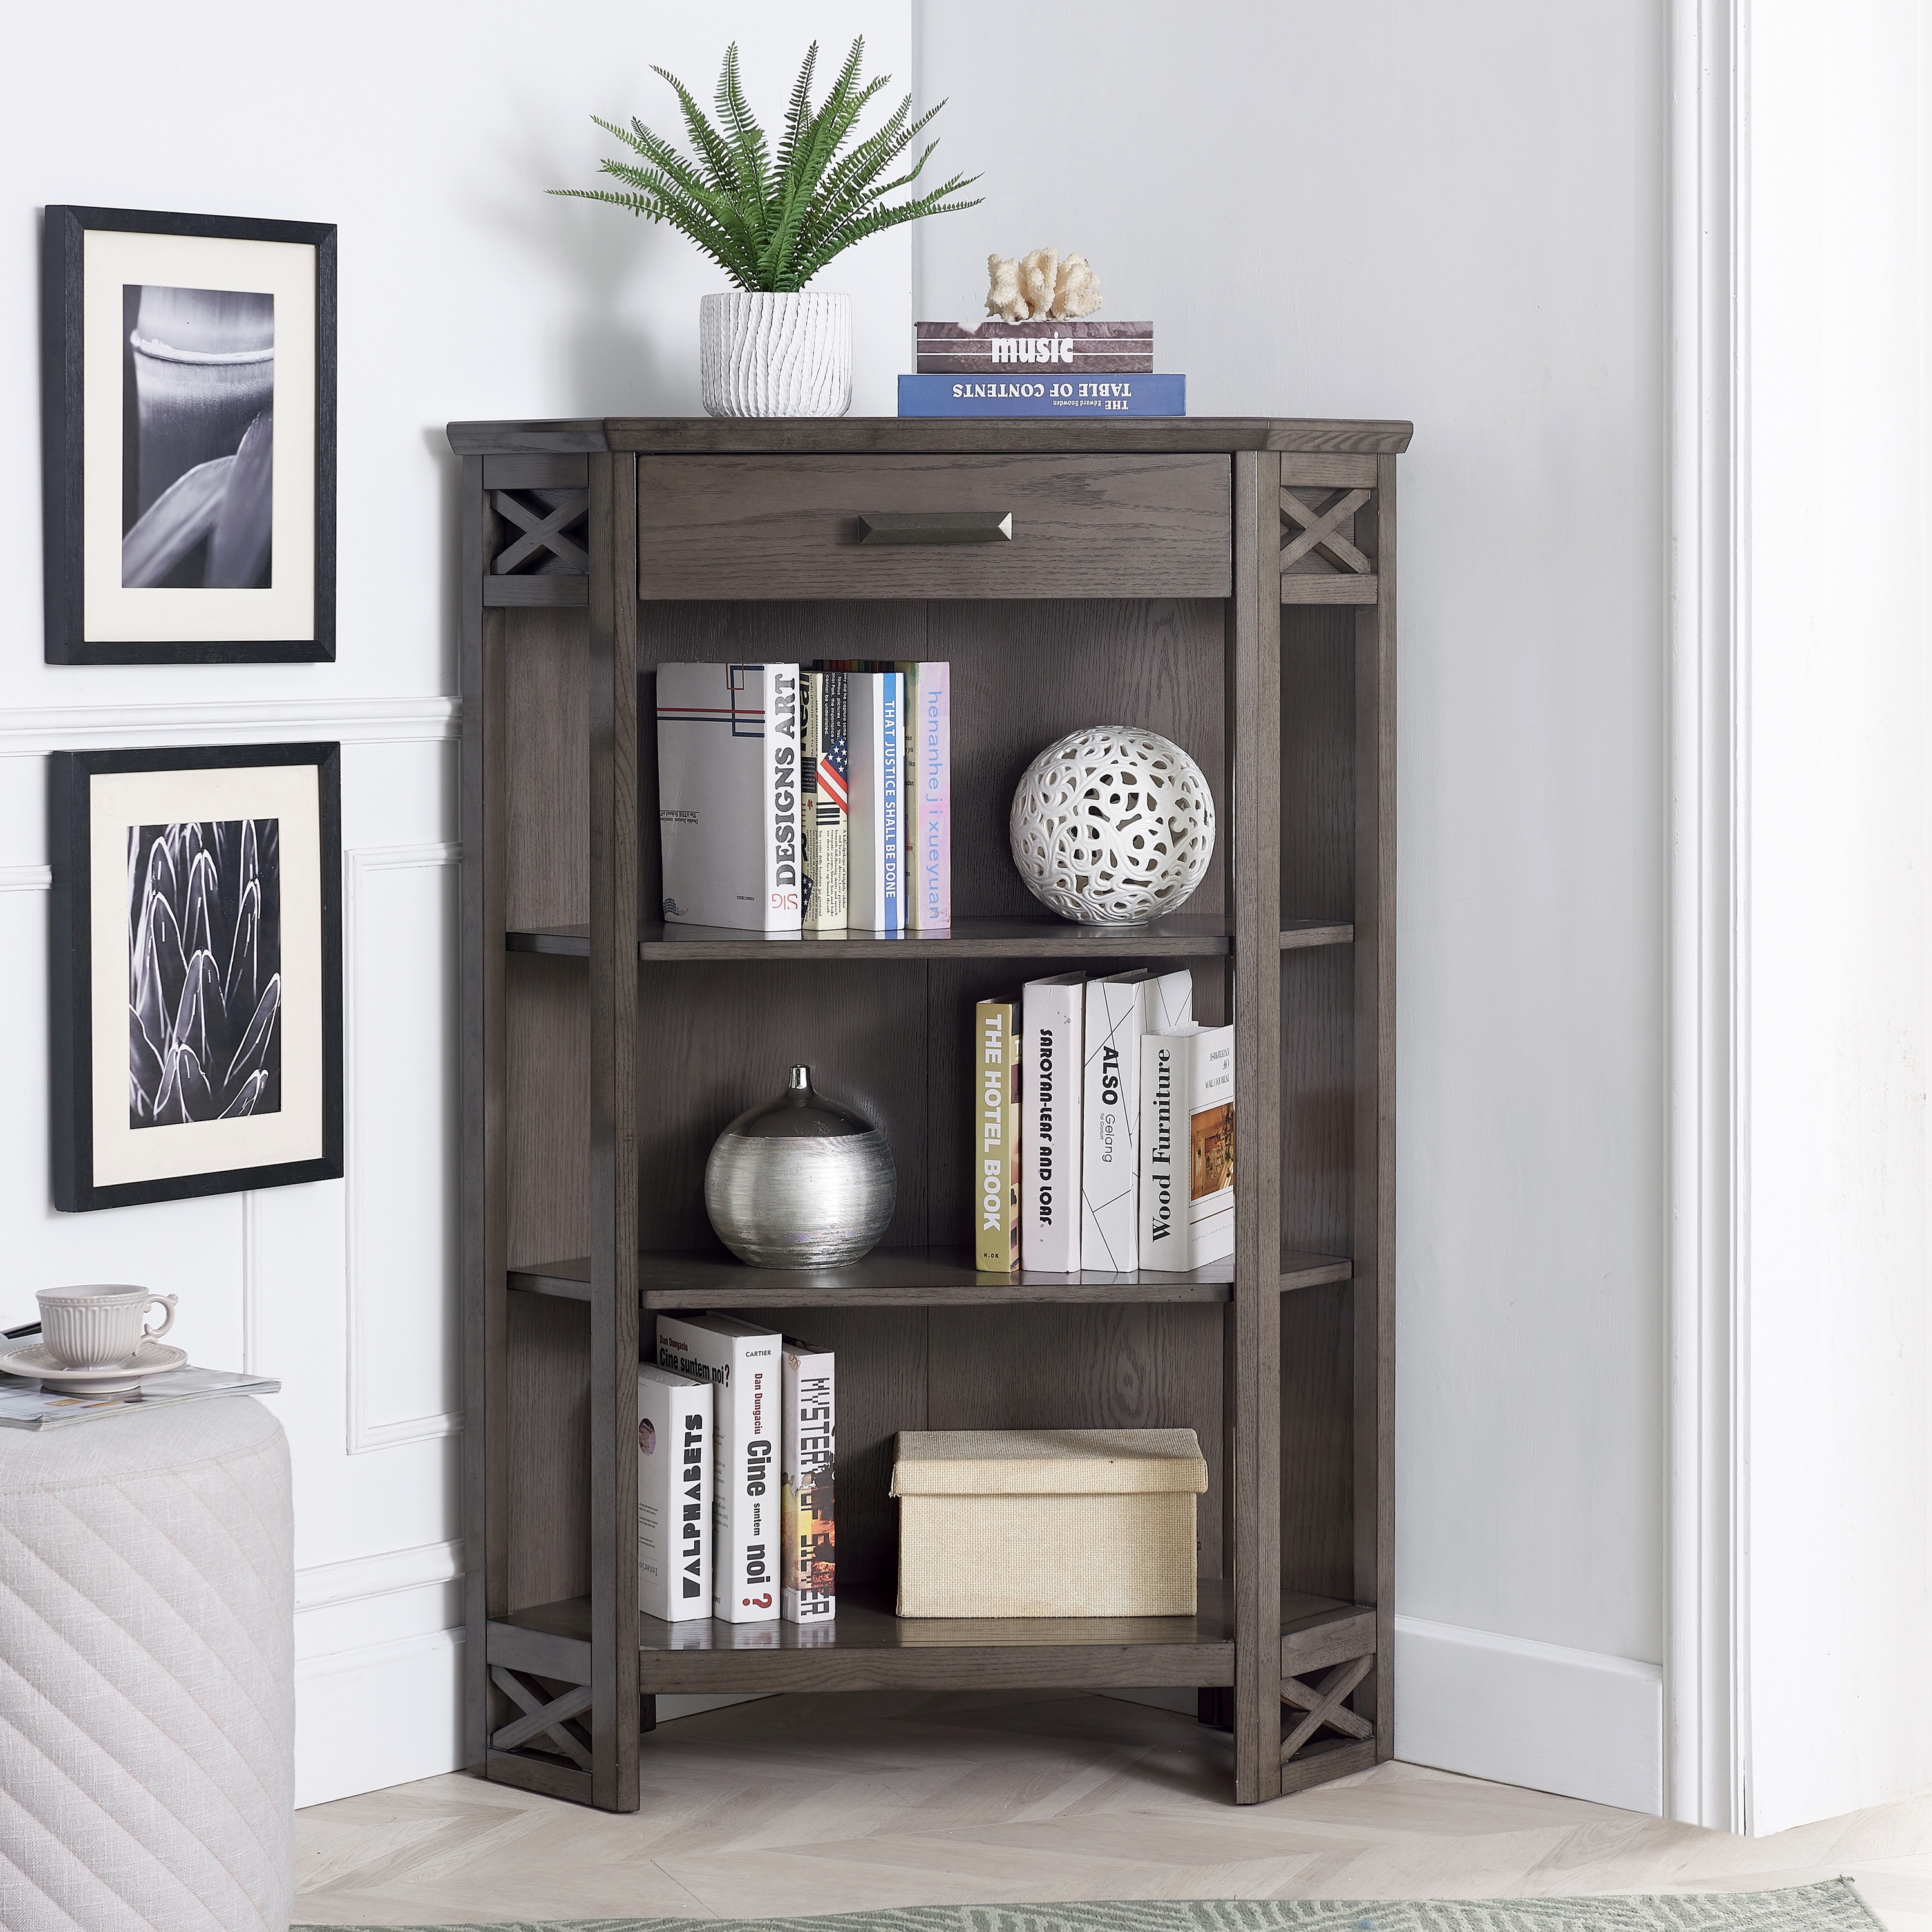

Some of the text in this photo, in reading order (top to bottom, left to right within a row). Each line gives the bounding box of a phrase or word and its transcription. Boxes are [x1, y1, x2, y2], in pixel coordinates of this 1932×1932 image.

[992, 332, 1074, 363] music
[952, 383, 1132, 398] TABLE OF CONTENTS
[1105, 400, 1129, 410] THE
[775, 674, 796, 887] DESIGNS ART
[884, 700, 896, 898] THAT JUSTICE SHALL BE DONE
[772, 894, 798, 910] SIG
[1222, 1059, 1229, 1070] OF
[983, 1014, 1002, 1231] THE HOTEL BOOK
[1102, 1046, 1119, 1162] ALSO Gelang
[1039, 1029, 1053, 1226] SAROYAN-LEAF AND LOAF
[1152, 1048, 1171, 1243] Wood Furniture
[659, 1335, 688, 1351] Dan Dungaciu
[659, 1347, 678, 1369] Cine
[680, 1358, 710, 1379] suntem
[754, 1374, 762, 1390] Dan
[753, 1393, 763, 1435] Dungaciu
[747, 1440, 772, 1496] Cine
[683, 1414, 702, 1577] ALPHABETS
[747, 1544, 771, 1584] noi
